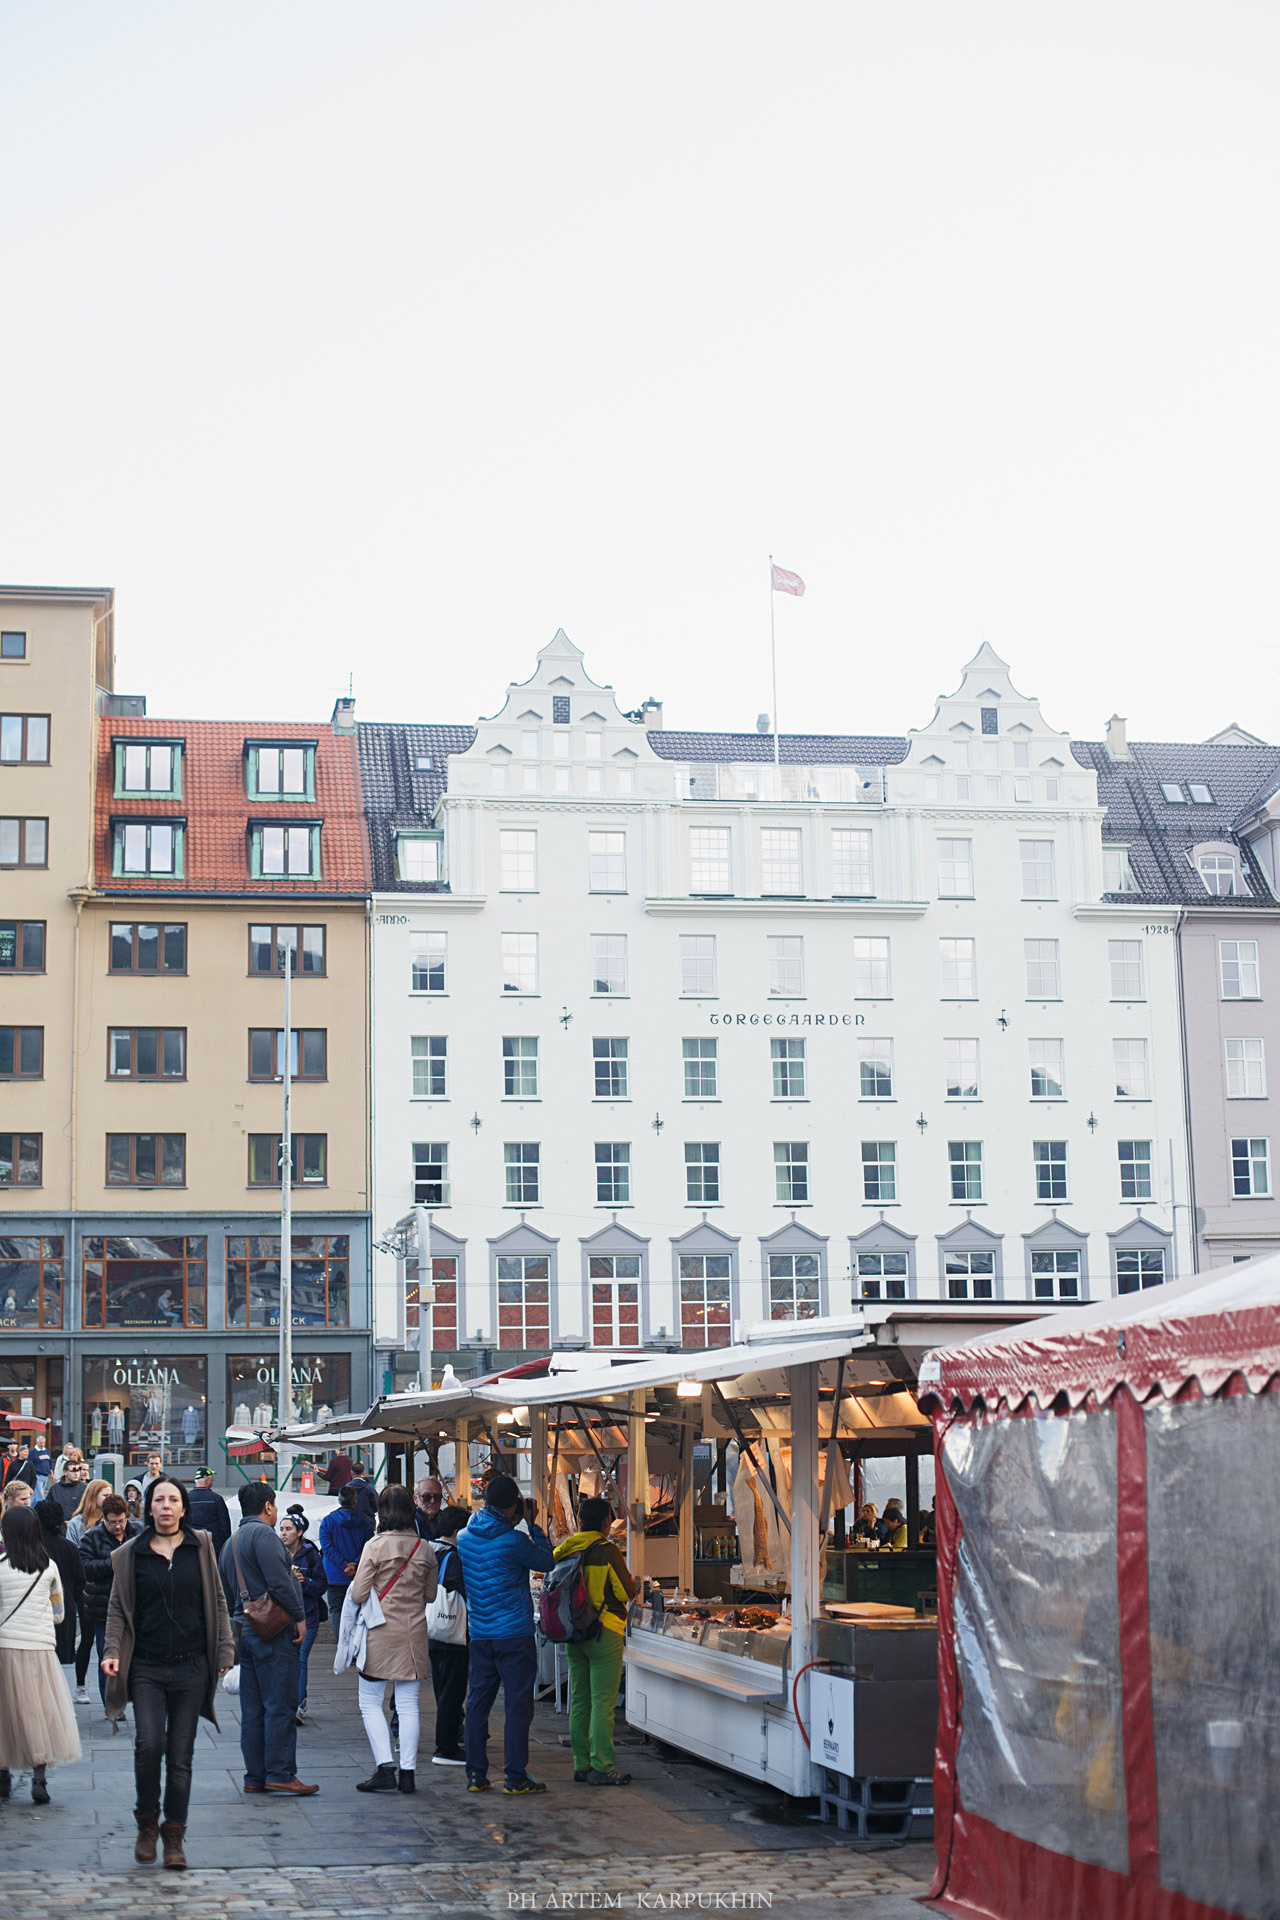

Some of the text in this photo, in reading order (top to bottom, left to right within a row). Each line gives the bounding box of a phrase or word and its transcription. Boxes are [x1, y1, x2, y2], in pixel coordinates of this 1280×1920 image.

[1145, 925, 1169, 935] 1928
[709, 1013, 865, 1026] TORGEGAARDEN
[269, 1317, 306, 1326] BJCK
[113, 1367, 180, 1386] OLEANA
[256, 1367, 323, 1384] OLANA
